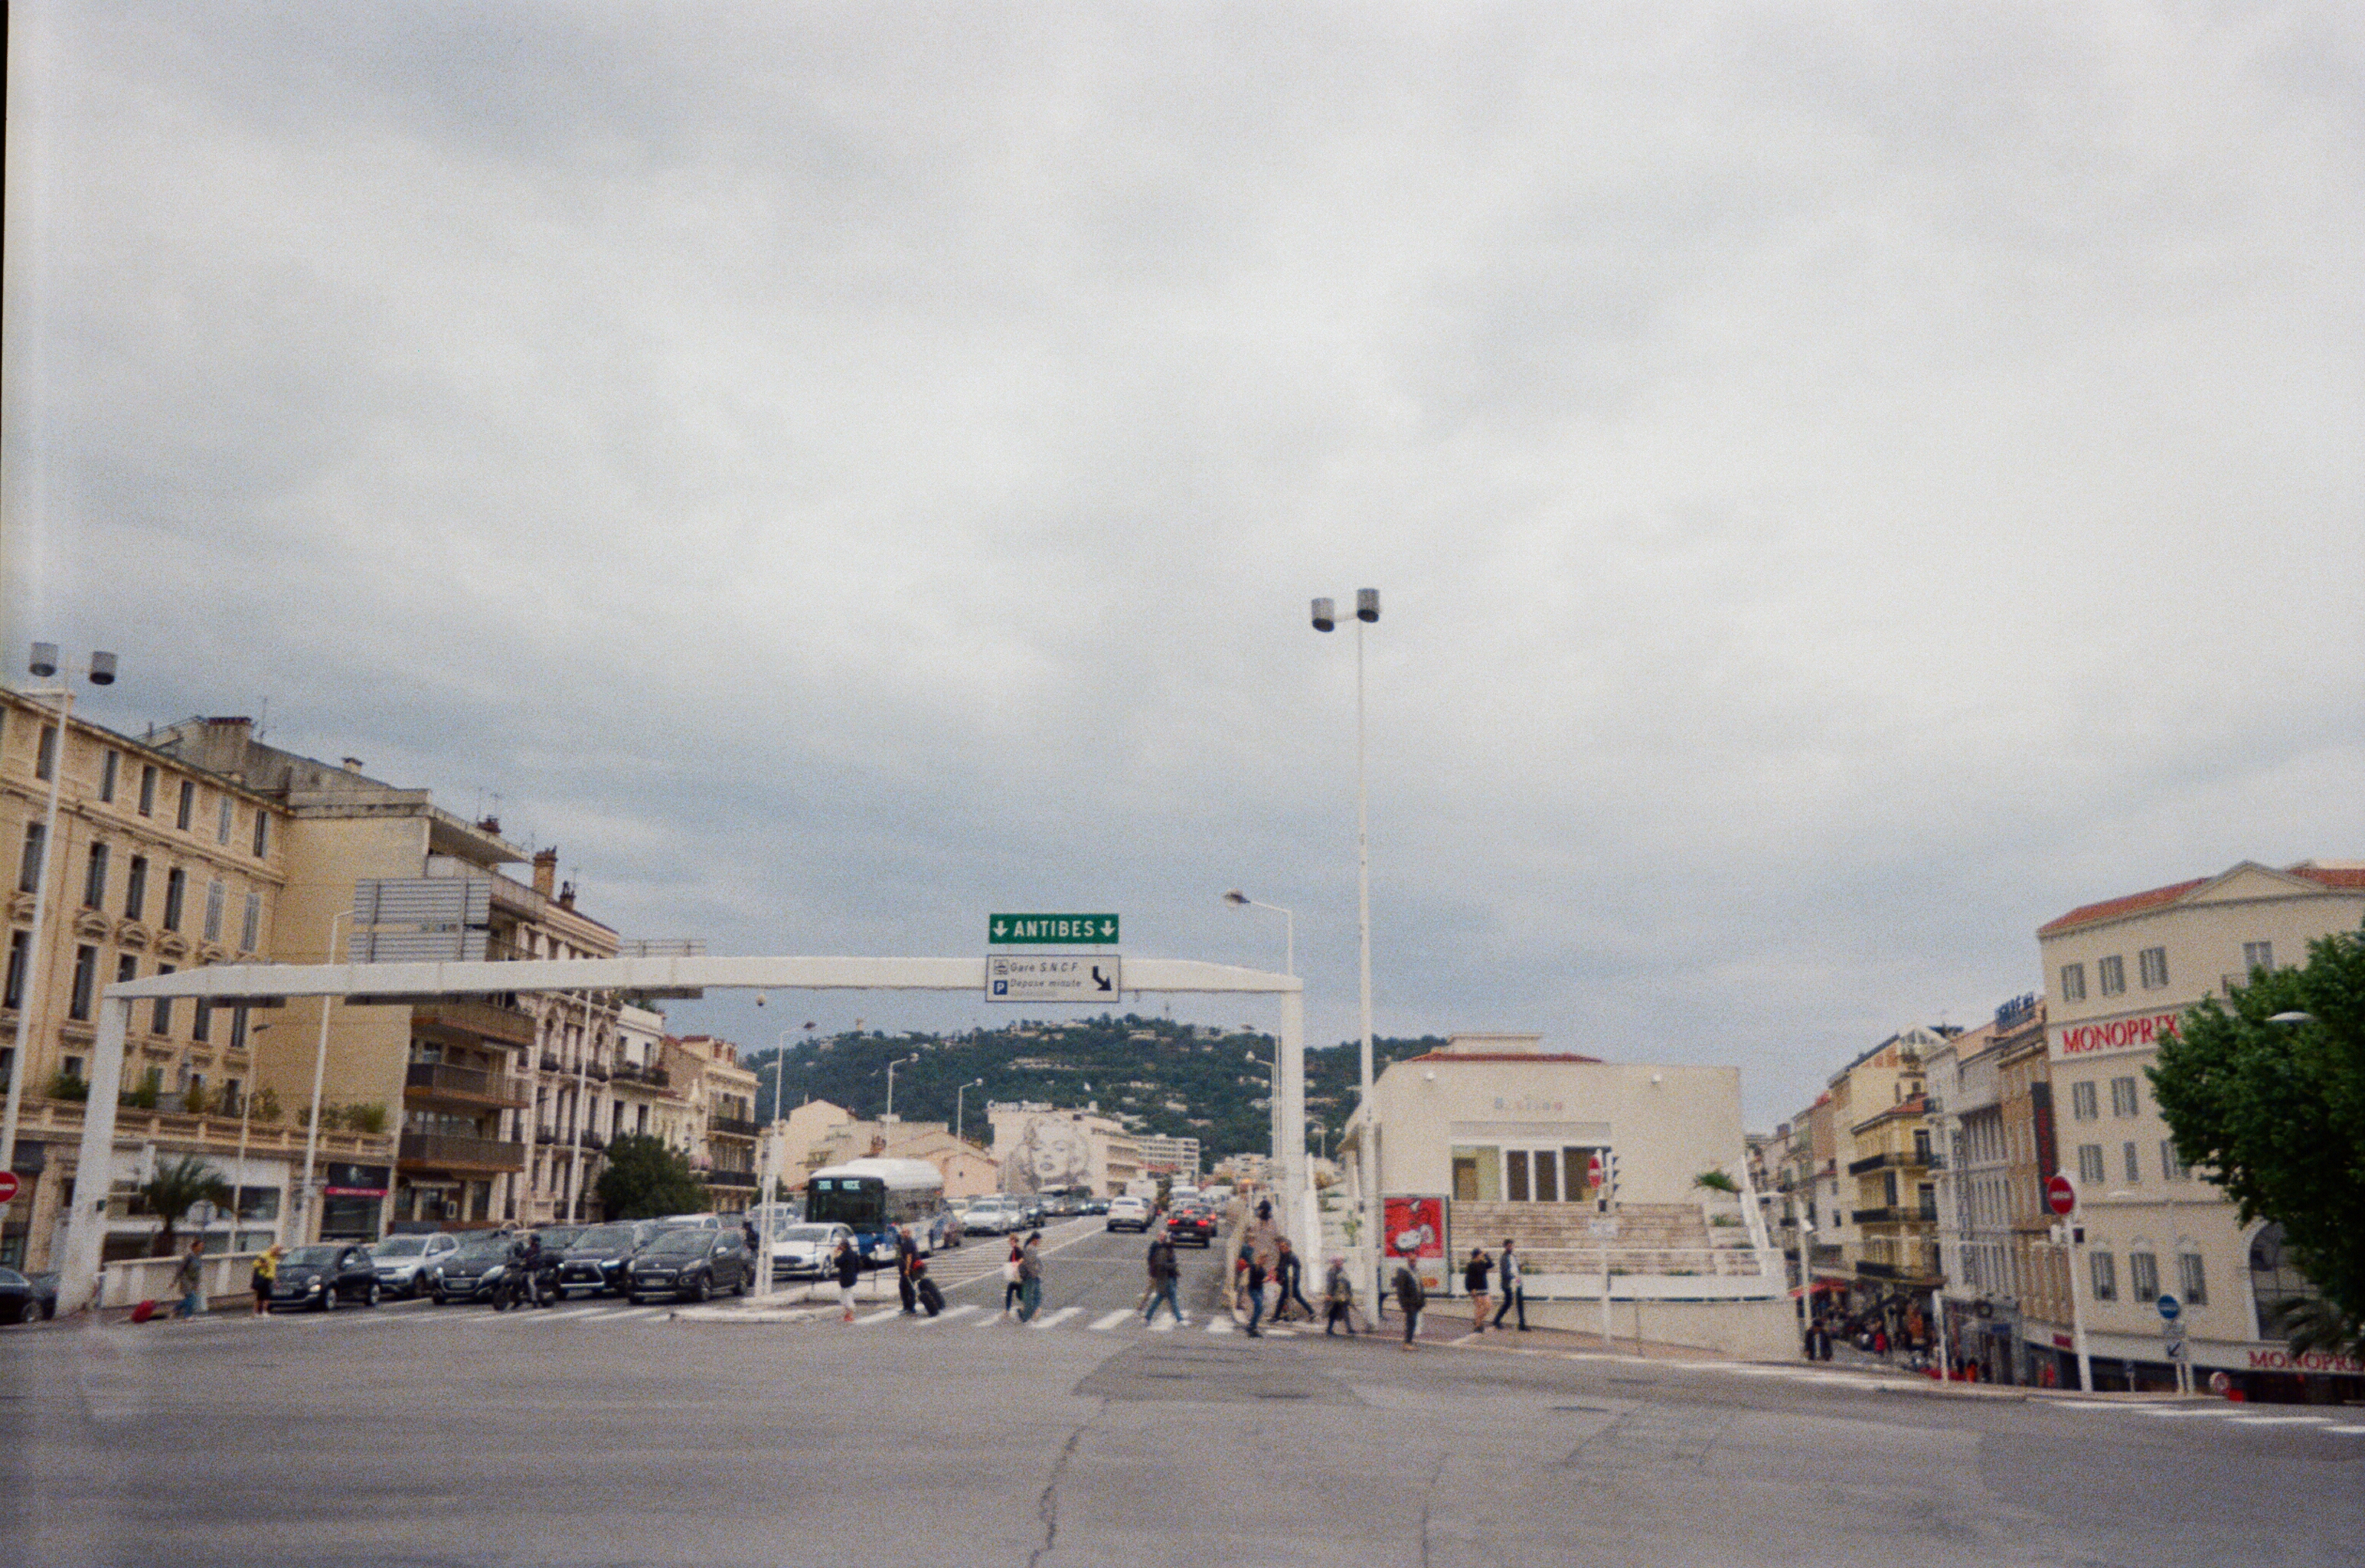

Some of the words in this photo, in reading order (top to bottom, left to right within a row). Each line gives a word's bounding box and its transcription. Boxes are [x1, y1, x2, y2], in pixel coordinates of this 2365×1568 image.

[1013, 920, 1095, 937] ANTIBES
[1011, 962, 1035, 972] Gare
[2249, 1350, 2365, 1372] MONOPRI
